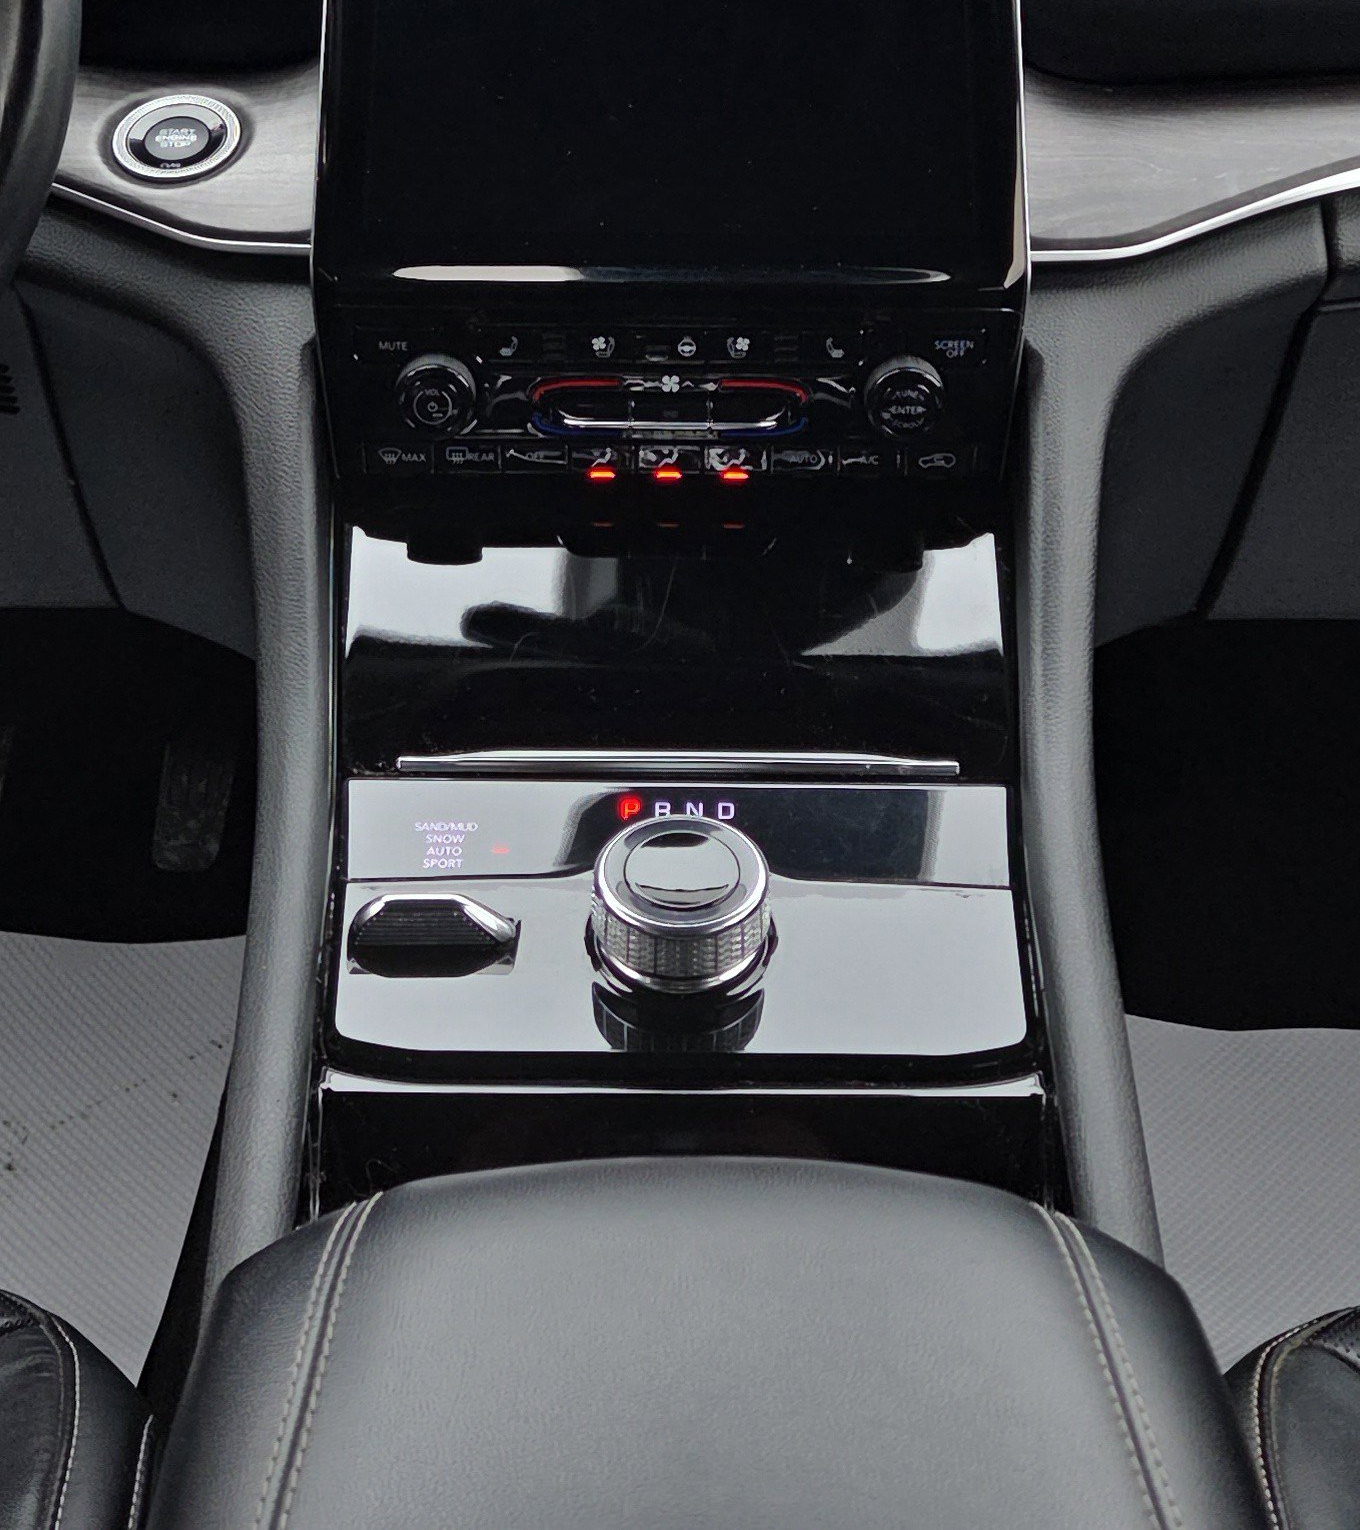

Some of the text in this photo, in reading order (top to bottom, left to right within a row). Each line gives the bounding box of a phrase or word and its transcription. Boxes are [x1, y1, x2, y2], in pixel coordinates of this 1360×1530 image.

[158, 128, 196, 136] START
[155, 134, 198, 143] ENGINE
[160, 140, 192, 148] STOP
[378, 341, 408, 352] MUTE
[934, 339, 975, 351] SCREEN
[946, 349, 965, 359] OFF
[424, 388, 440, 397] VOL
[401, 452, 427, 462] MAX
[467, 451, 495, 462] REAR
[791, 453, 818, 464] AUTO
[623, 802, 641, 818] P
[685, 802, 704, 818] N
[717, 802, 735, 820] D
[414, 821, 479, 832] SAND/MUD
[425, 834, 465, 844] SNOW
[426, 847, 463, 857] AUTO
[422, 858, 464, 869] SPORT
